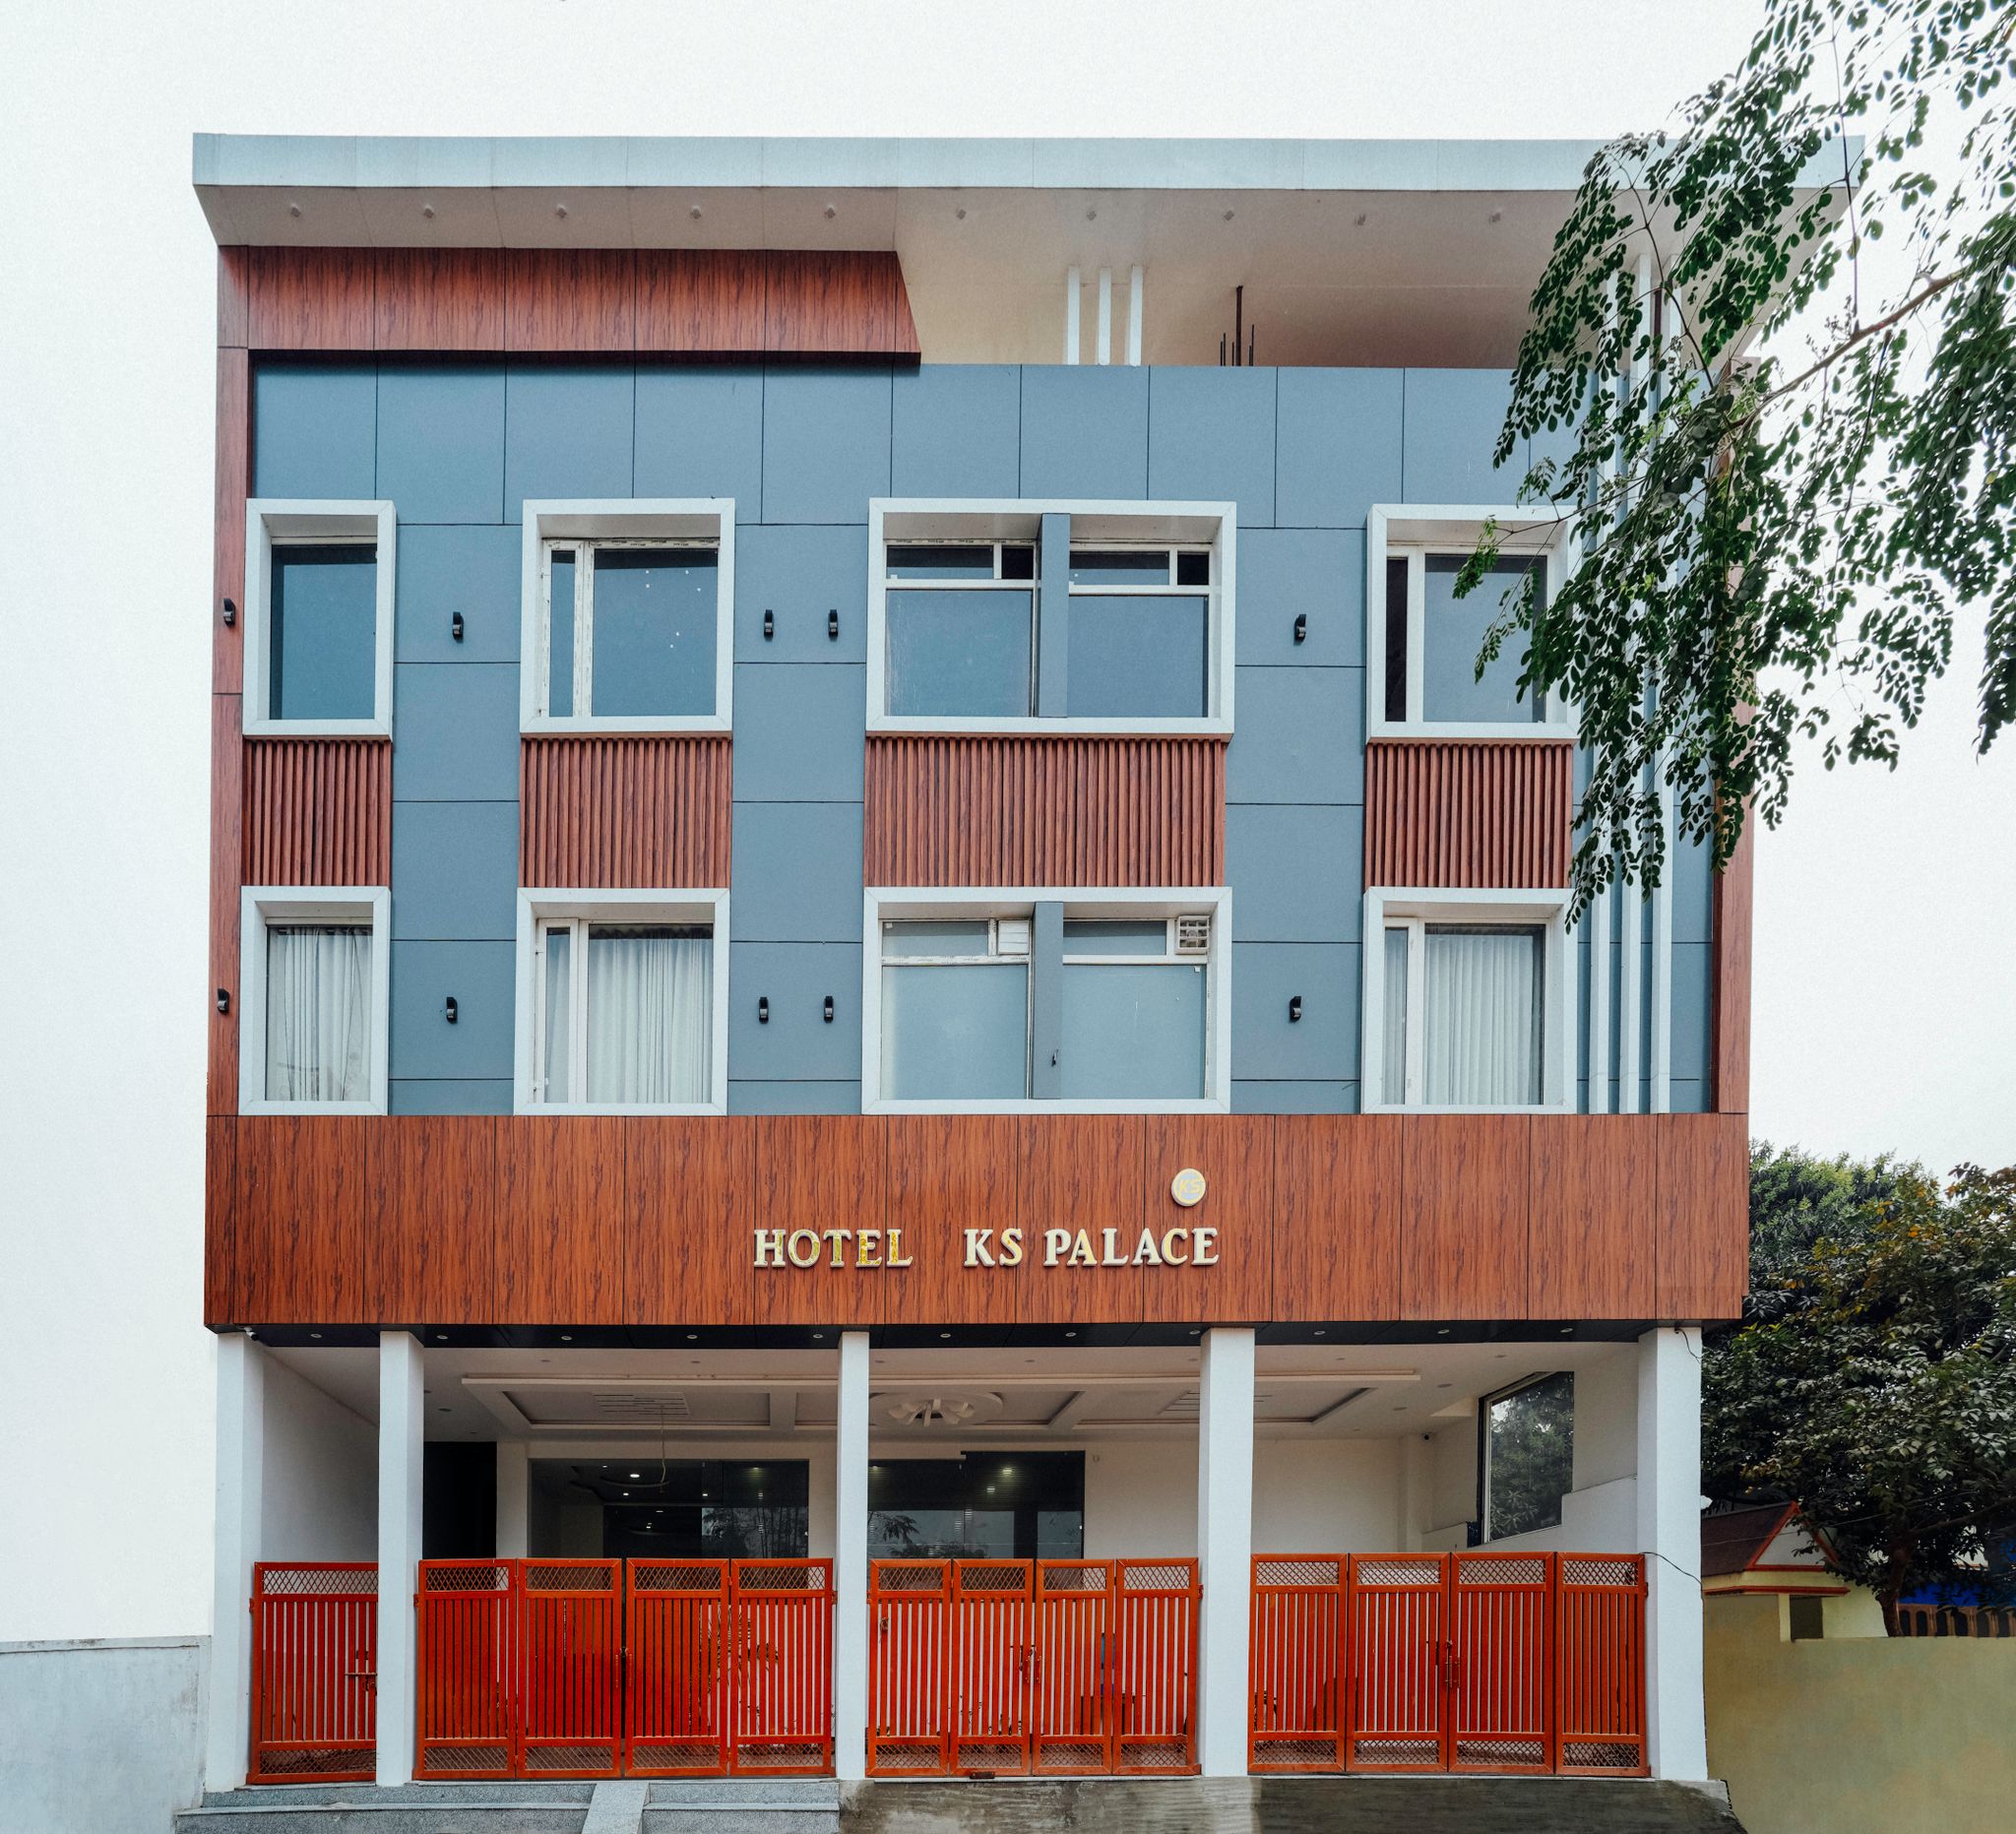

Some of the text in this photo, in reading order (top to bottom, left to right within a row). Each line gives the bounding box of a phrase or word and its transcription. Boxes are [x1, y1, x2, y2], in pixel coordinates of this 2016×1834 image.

[1178, 1178, 1200, 1198] KS
[753, 1227, 1220, 1268] HOTEL KS PALACE
